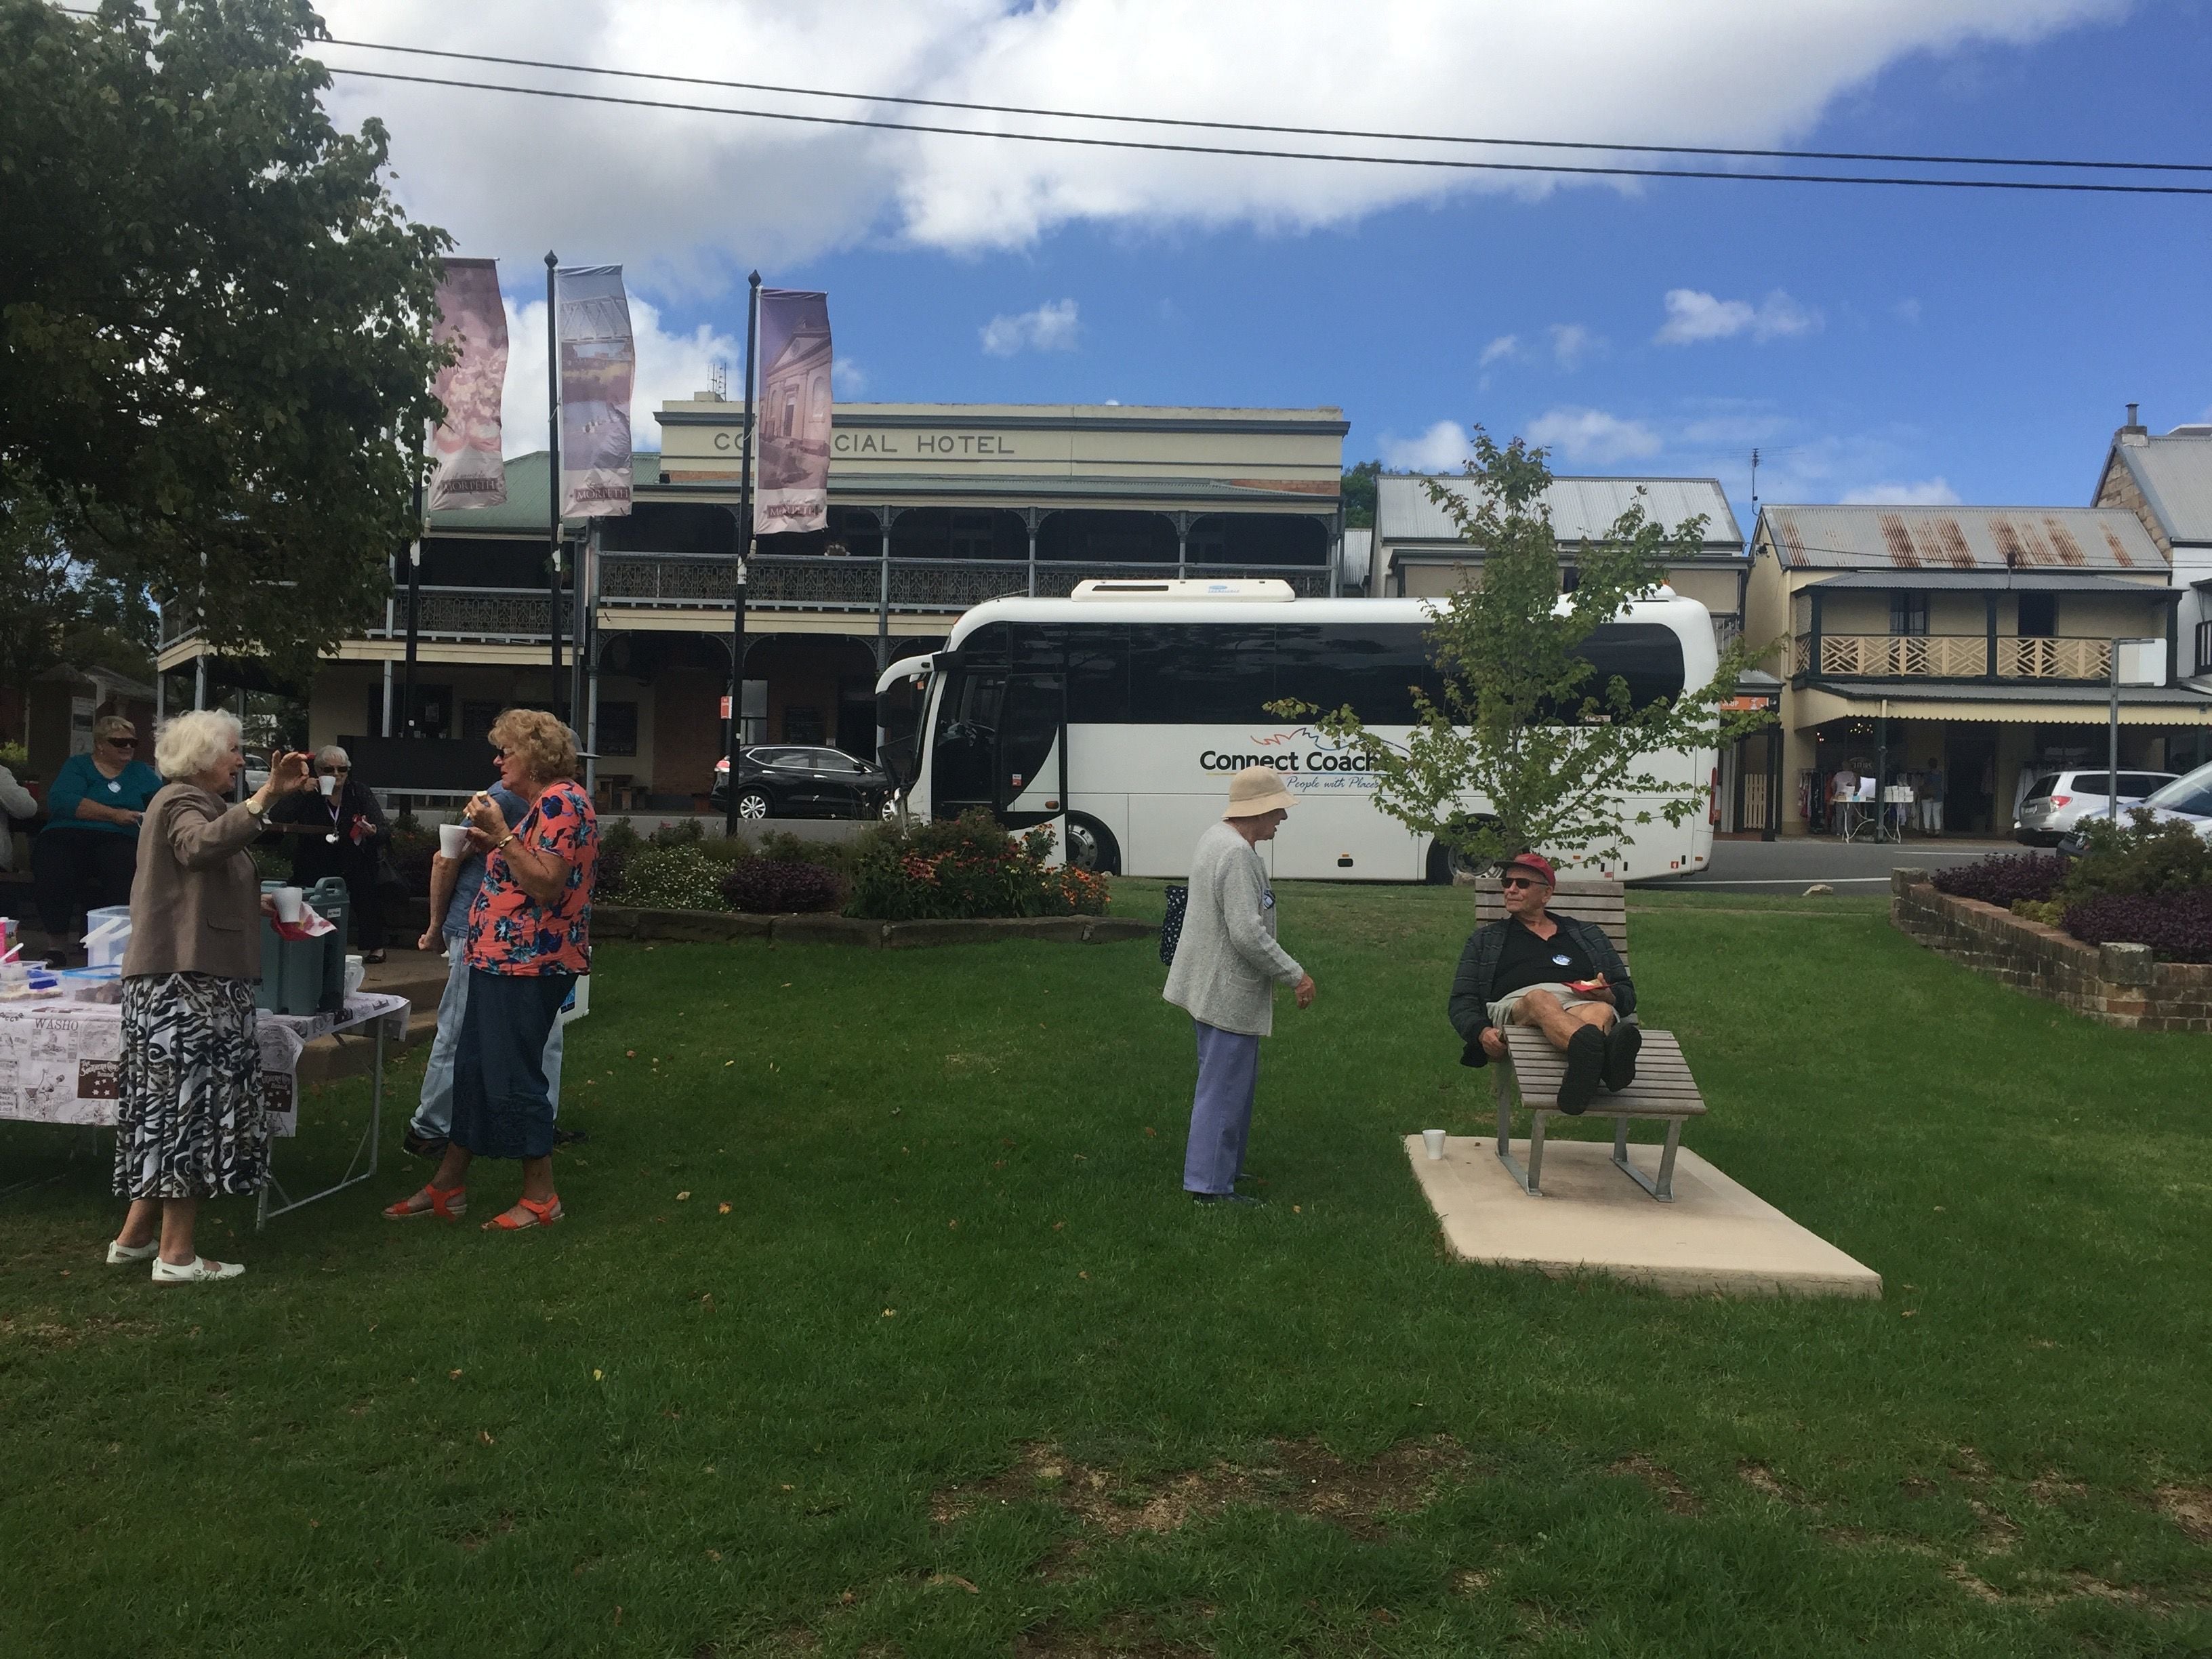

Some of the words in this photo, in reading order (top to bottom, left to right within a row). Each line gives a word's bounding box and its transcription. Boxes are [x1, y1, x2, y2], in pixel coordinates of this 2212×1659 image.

[917, 434, 1015, 454] HOTEL
[443, 480, 495, 492] MORPETH
[576, 488, 629, 500] MORPETH
[1200, 750, 1299, 771] Connect
[1307, 745, 1407, 771] Coach
[1287, 775, 1320, 792] People
[1324, 777, 1345, 788] with
[1349, 776, 1379, 789] Places
[35, 1019, 79, 1031] WASHO
